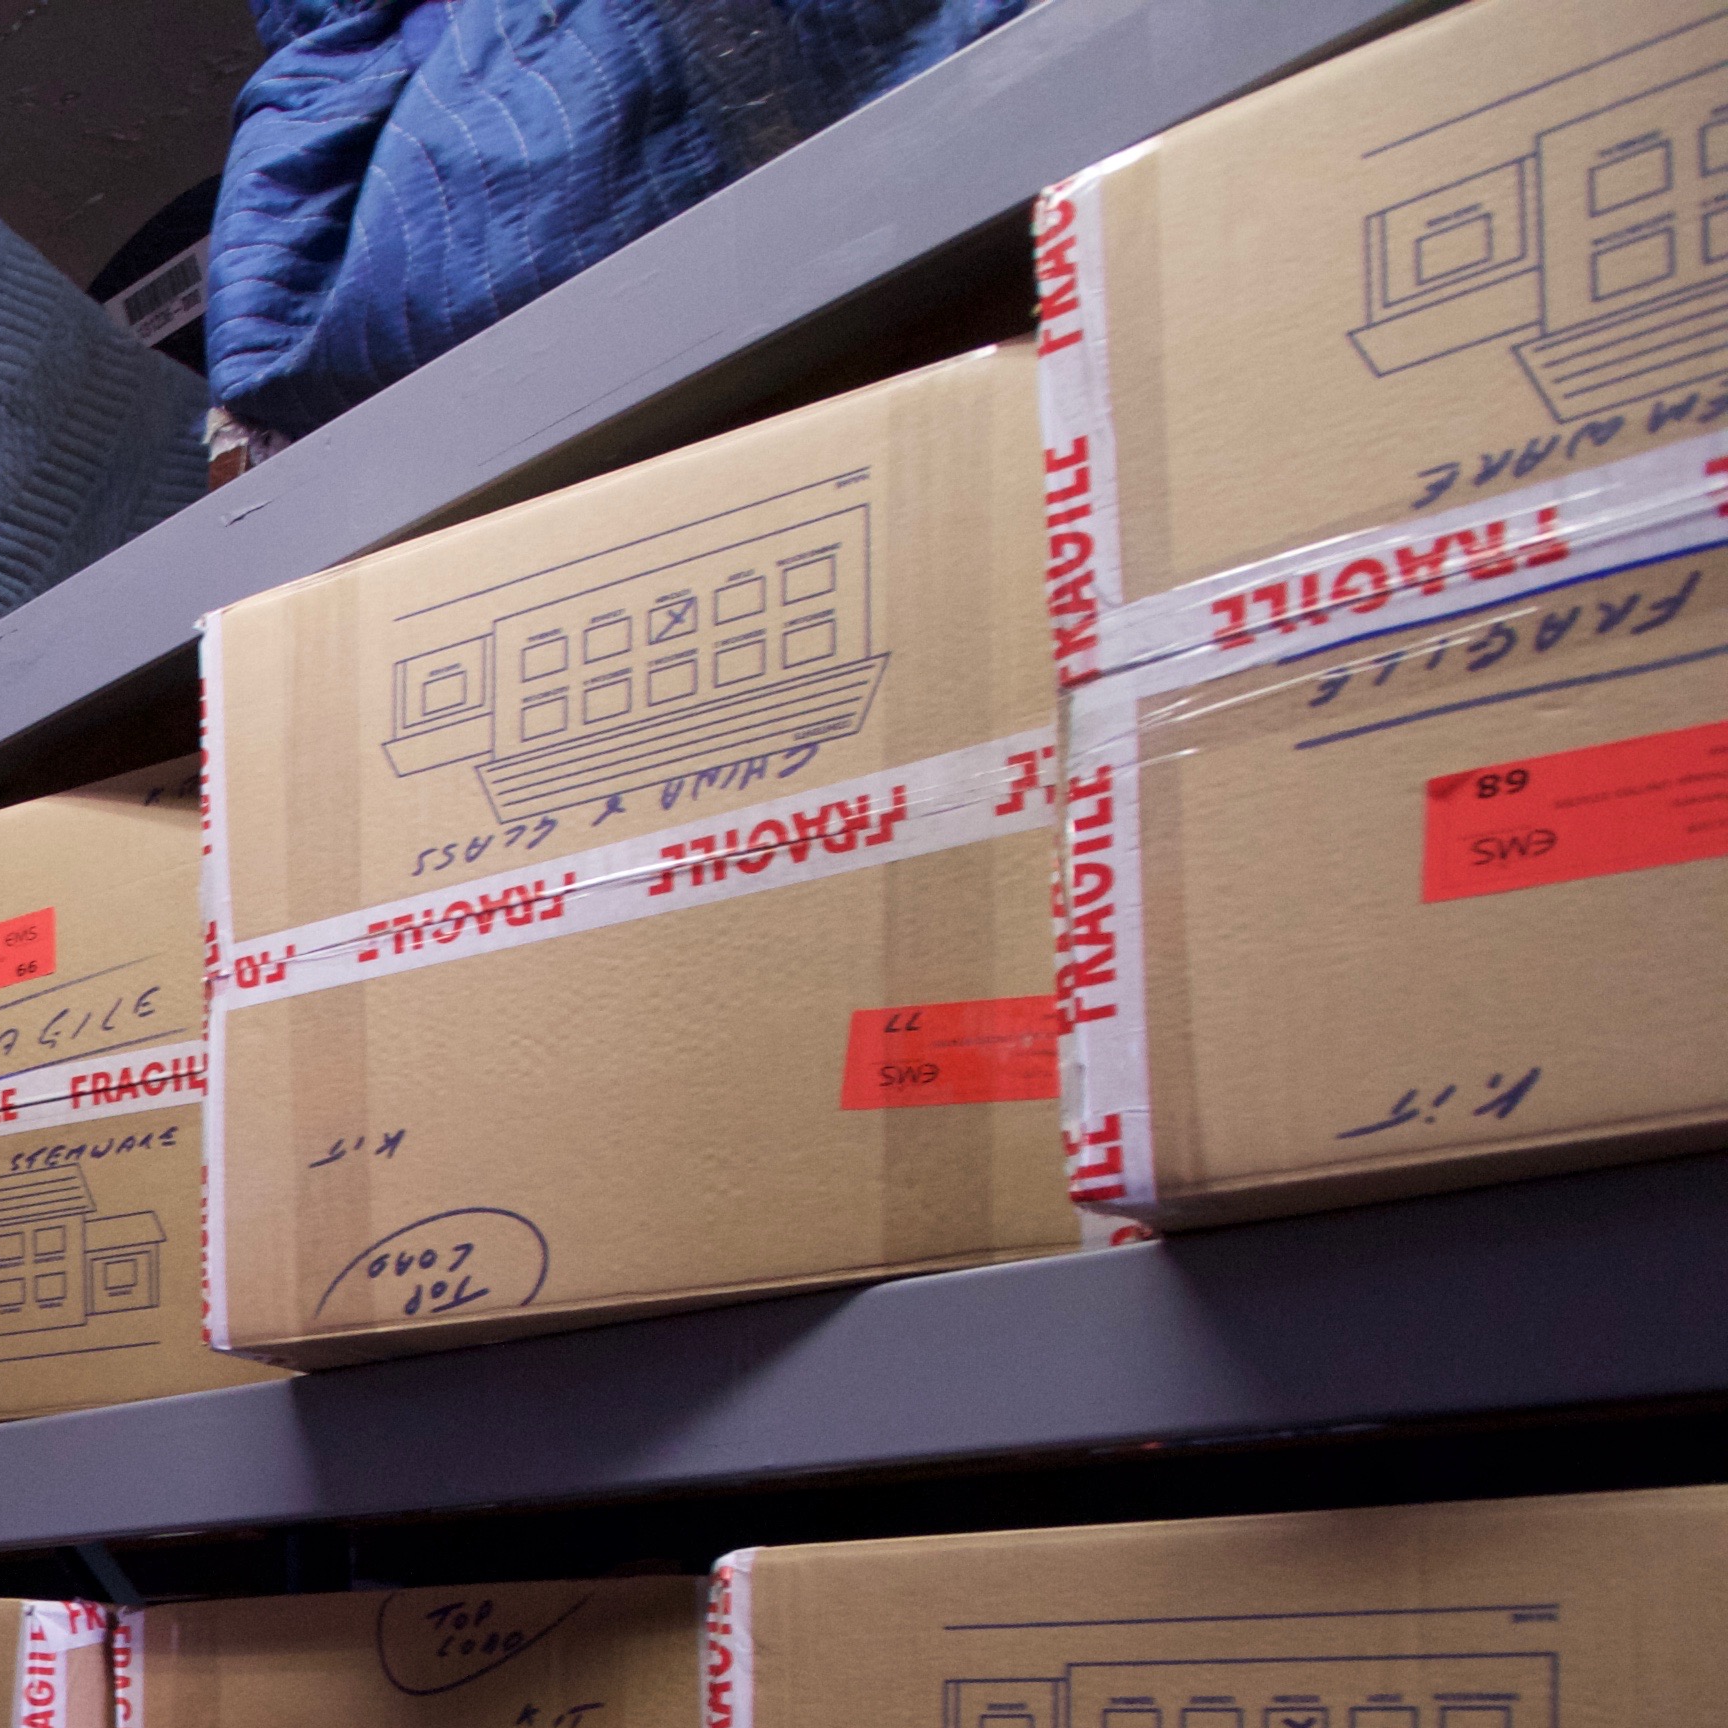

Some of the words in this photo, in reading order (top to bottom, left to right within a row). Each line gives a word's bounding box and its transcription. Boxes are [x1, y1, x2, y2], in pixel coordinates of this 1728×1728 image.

[1043, 434, 1100, 691] FRAGILE
[1210, 503, 1570, 651] FRAGILE
[1308, 570, 1702, 708] FRAGILE
[659, 742, 821, 812] CHINA
[1476, 768, 1530, 799] 68
[413, 817, 559, 877] GLASS
[648, 784, 907, 898] FRAGILE
[1470, 828, 1558, 866] EMS
[356, 871, 577, 963] FRAGILE
[1069, 763, 1121, 1026] FRAGILE
[882, 1011, 923, 1034] 77
[878, 1062, 941, 1089] EMS
[9, 1125, 180, 1173] STEMWARE
[367, 1242, 475, 1280] LOAD
[402, 1274, 490, 1316] TOP
